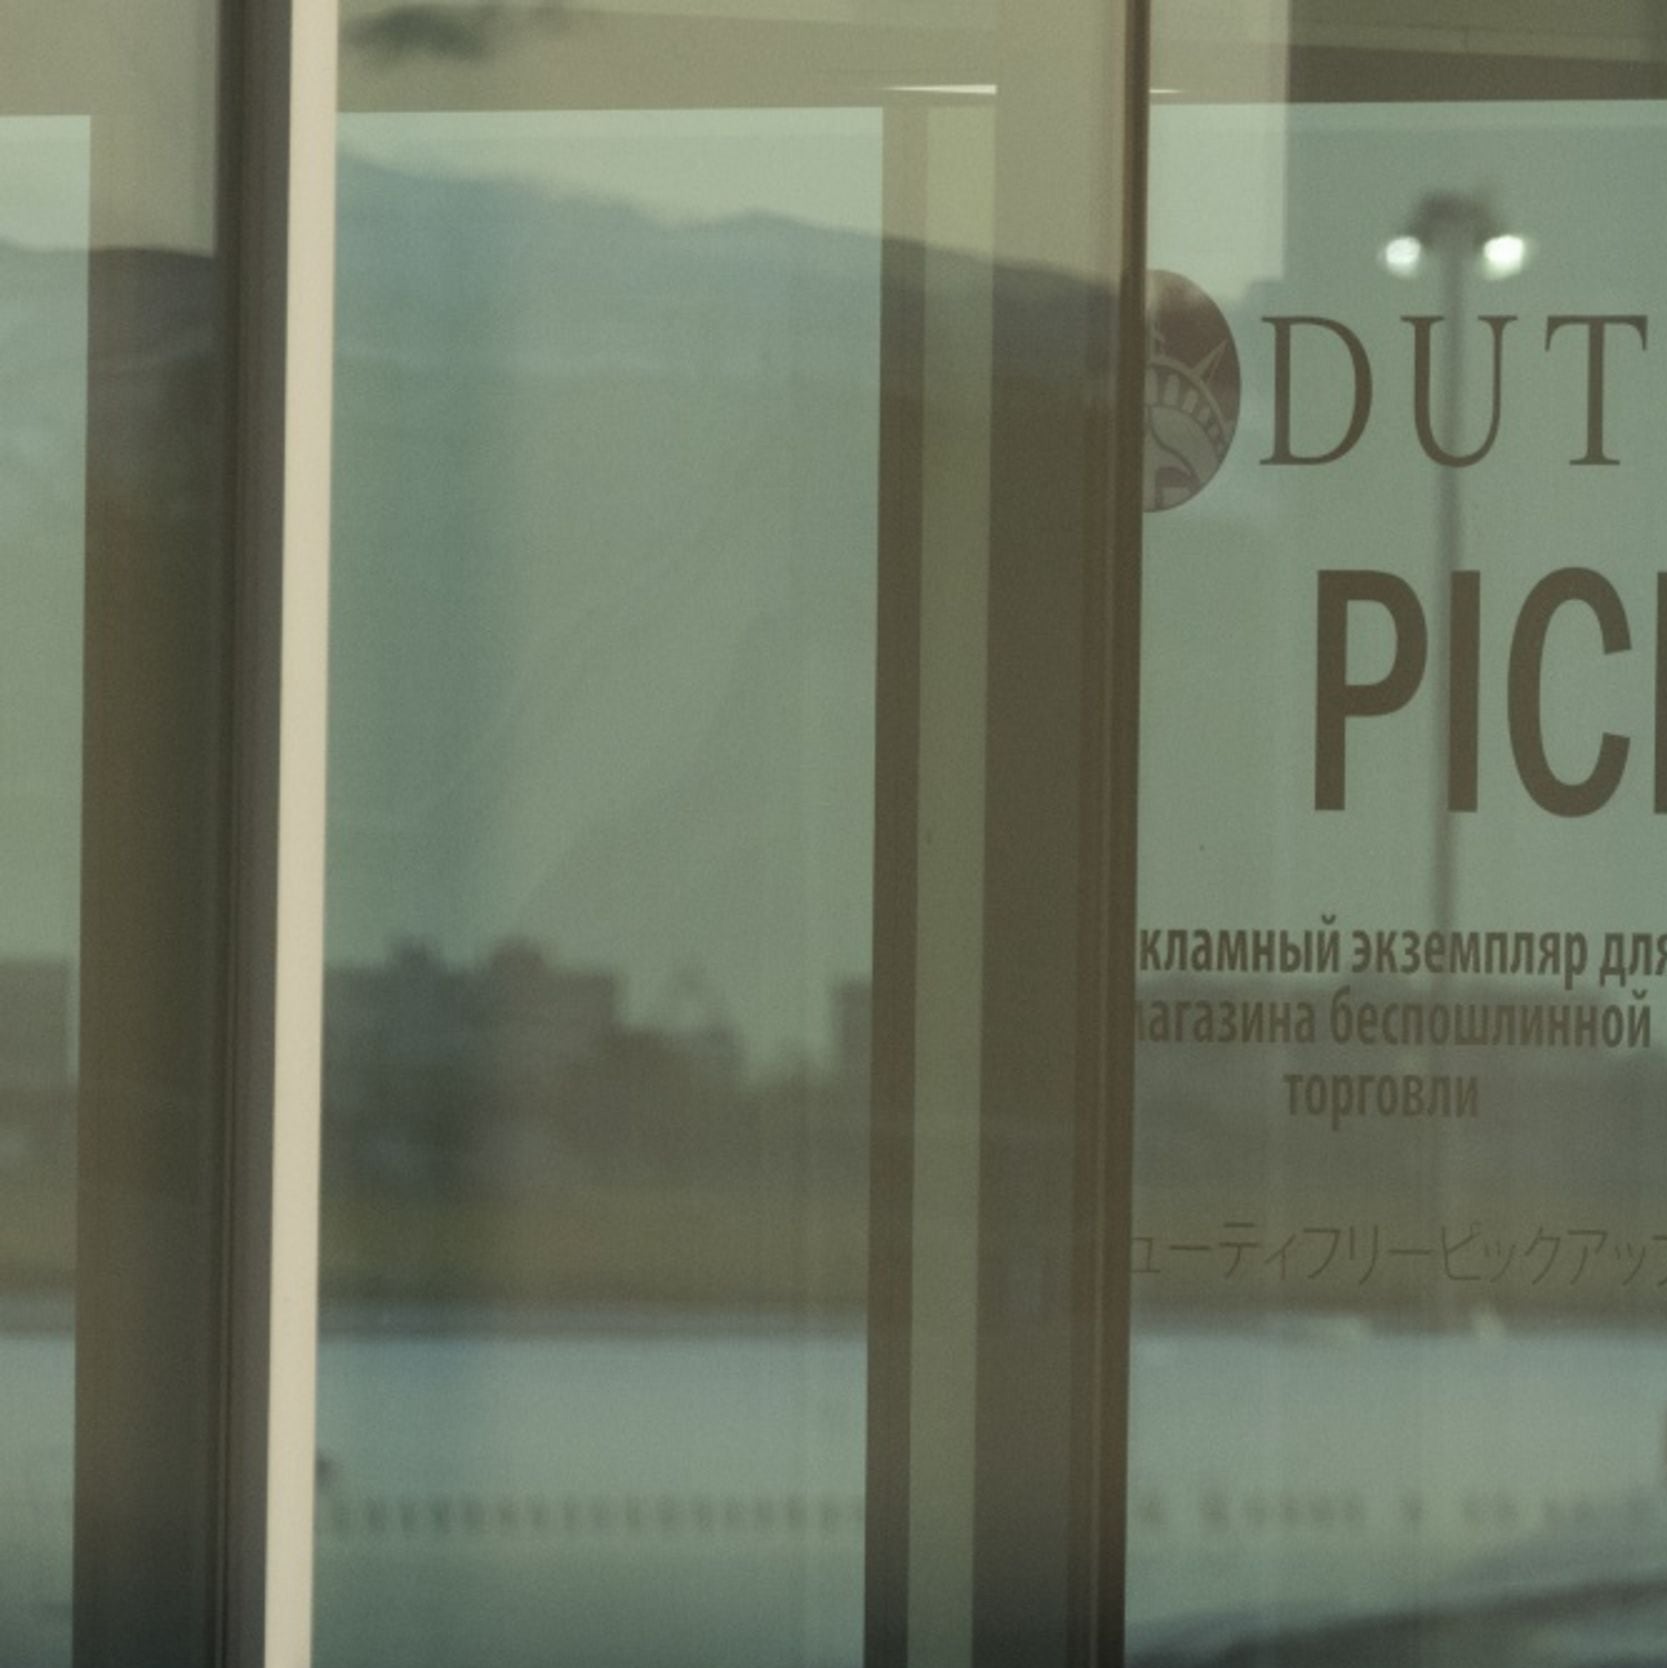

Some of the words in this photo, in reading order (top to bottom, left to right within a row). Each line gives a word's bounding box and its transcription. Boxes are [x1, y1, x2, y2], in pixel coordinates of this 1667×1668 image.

[1352, 929, 1588, 990] экземпляр
[1136, 1000, 1316, 1044] агазина
[1330, 985, 1652, 1047] беспошлинной
[1283, 1074, 1479, 1131] торговли
